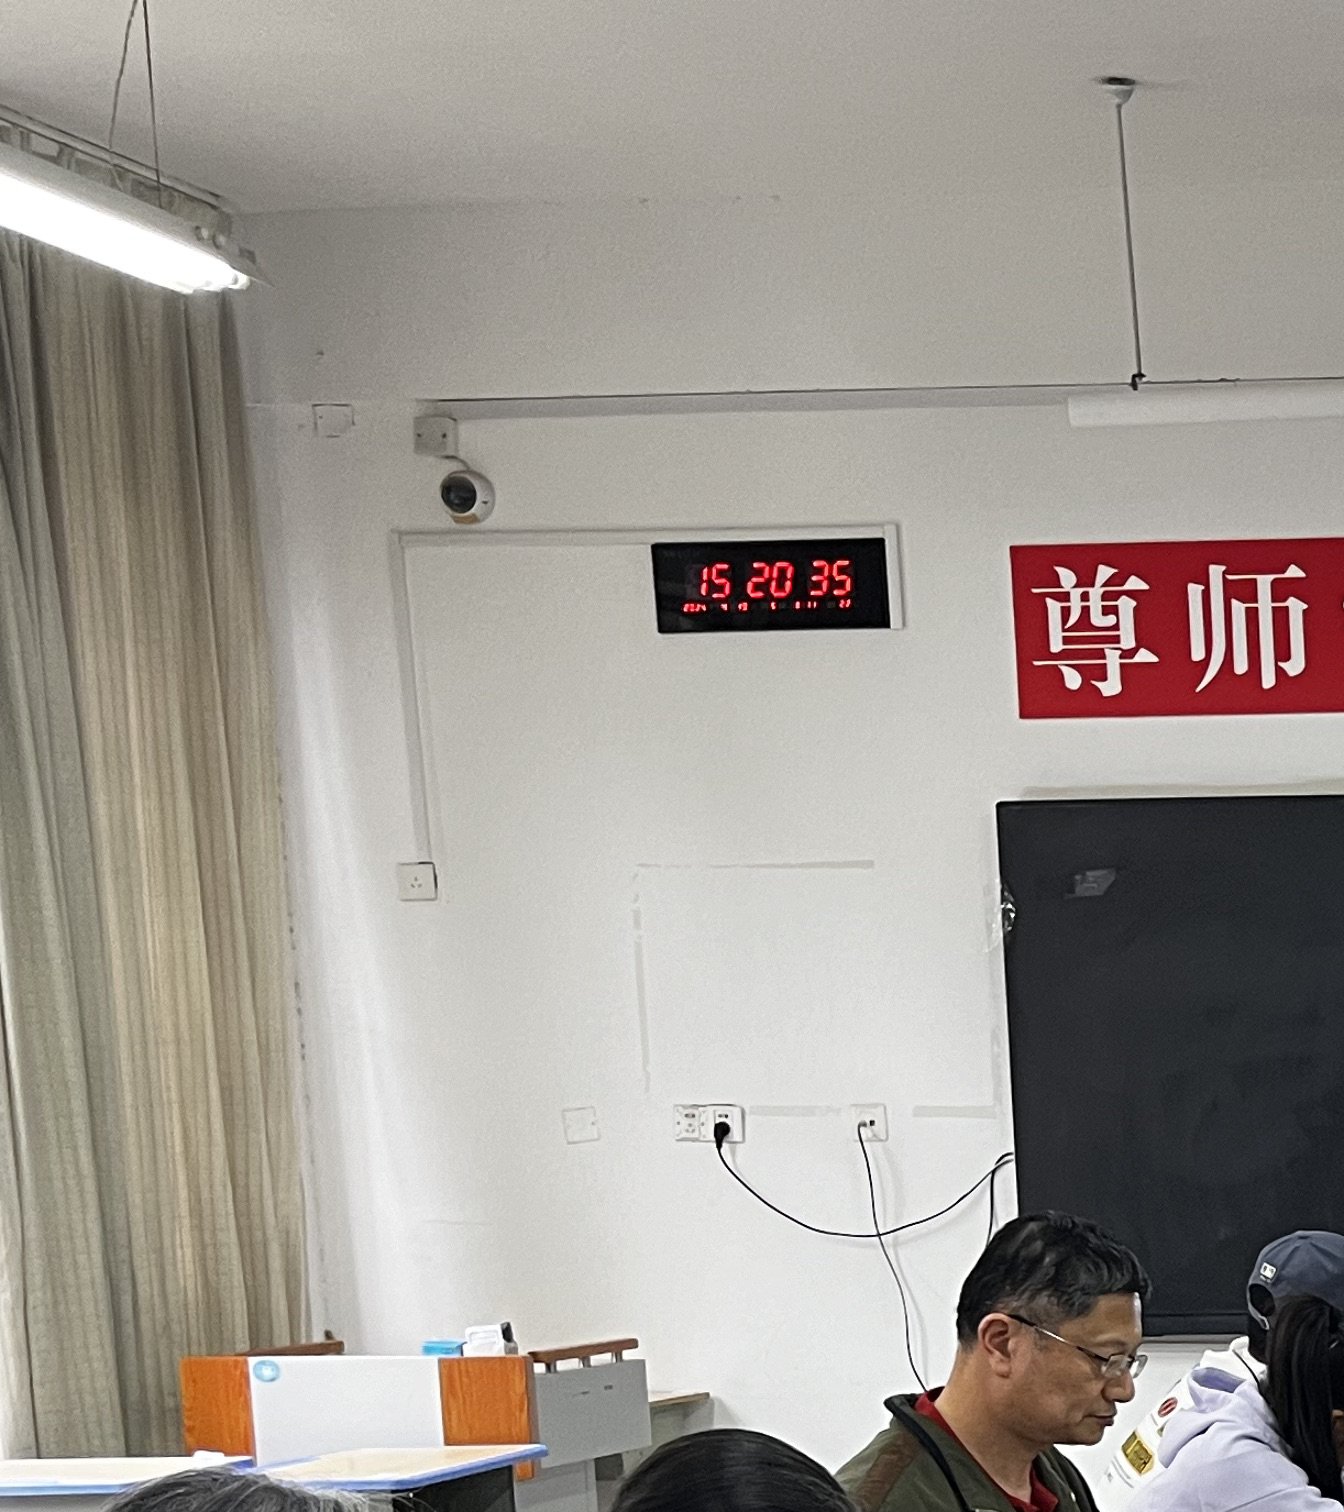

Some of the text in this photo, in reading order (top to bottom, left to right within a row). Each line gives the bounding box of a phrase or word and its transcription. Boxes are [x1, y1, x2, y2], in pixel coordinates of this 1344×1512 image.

[700, 560, 852, 599] 15 20 35
